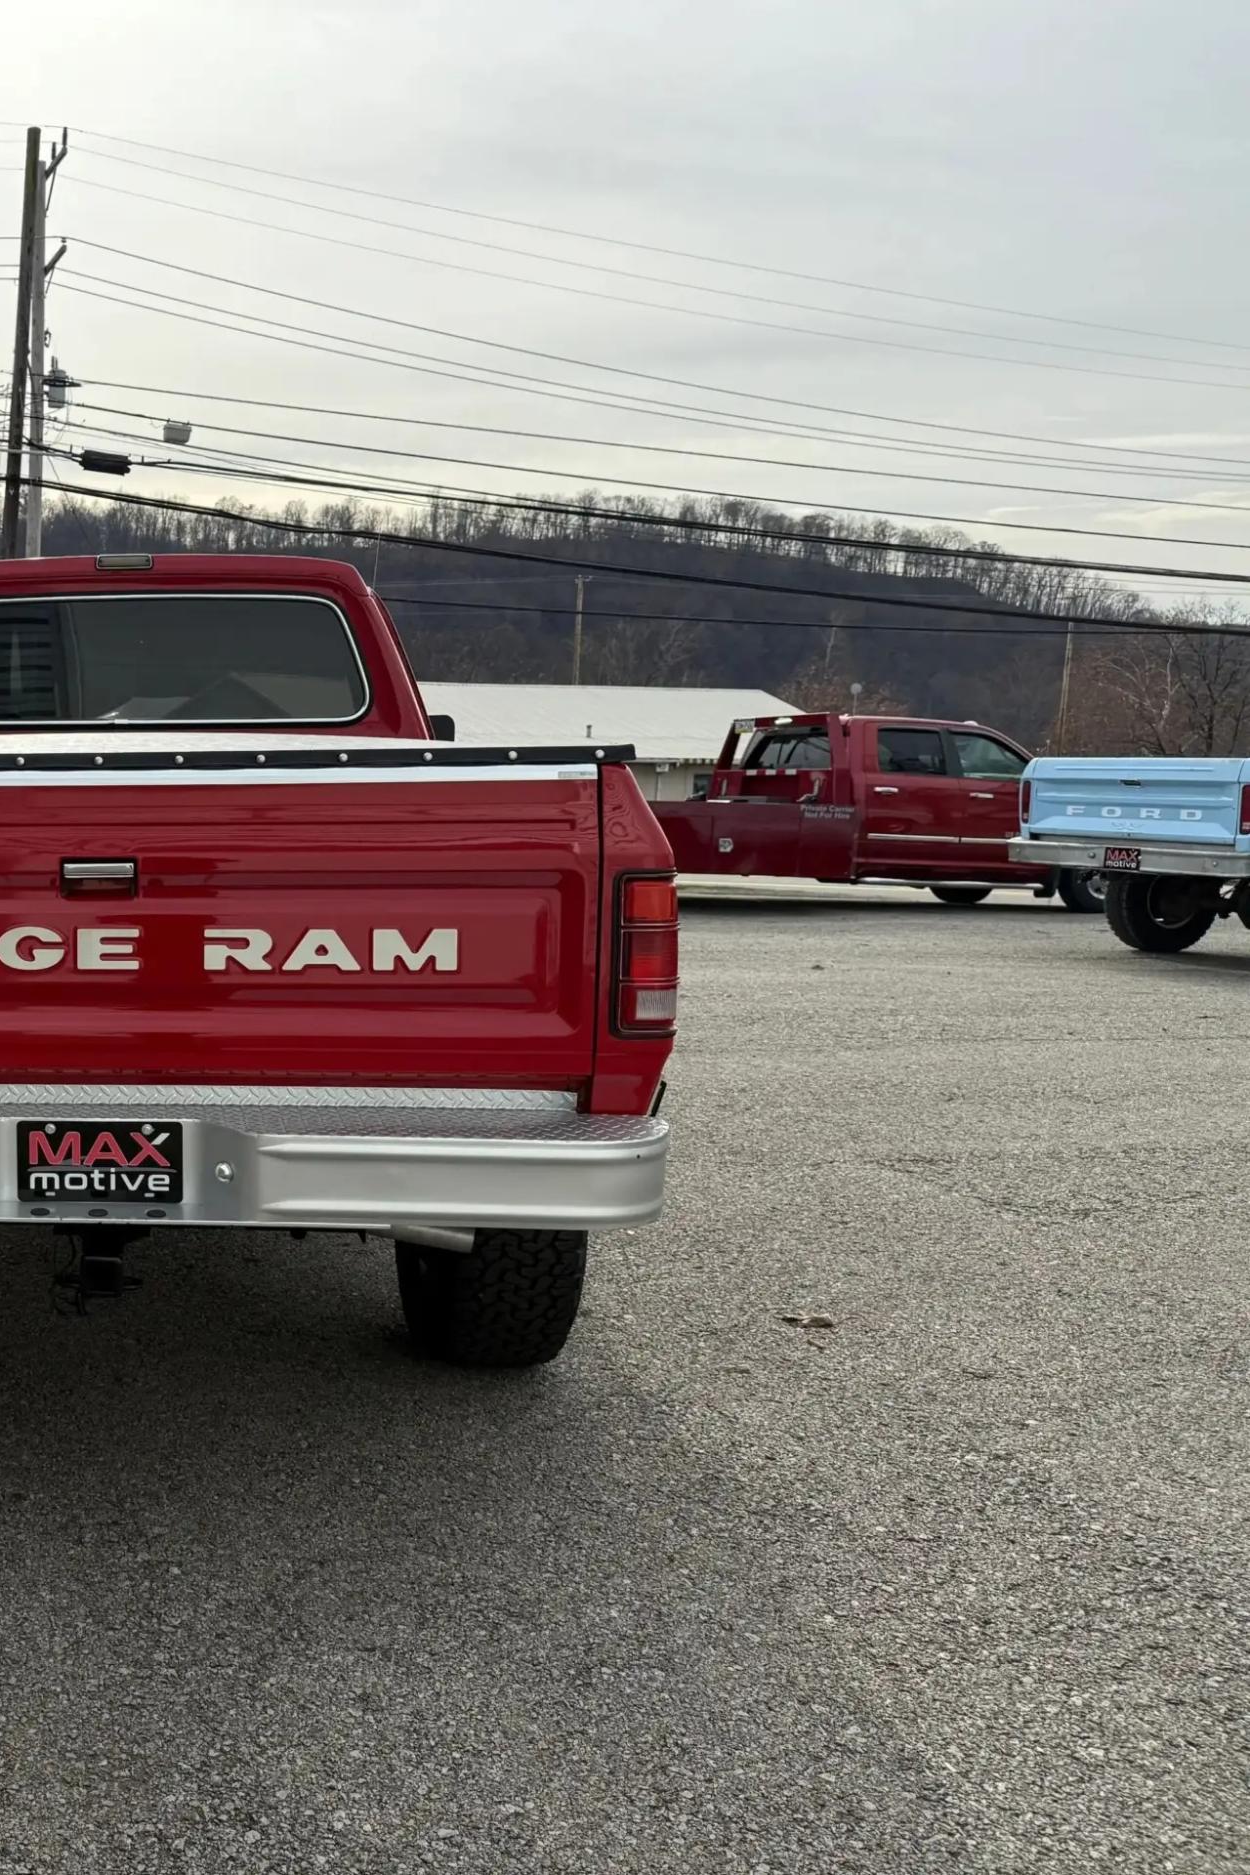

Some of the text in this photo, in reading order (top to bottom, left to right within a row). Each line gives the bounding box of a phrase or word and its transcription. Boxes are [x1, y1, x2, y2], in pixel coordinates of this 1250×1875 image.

[1065, 805, 1203, 821] FORD
[1105, 859, 1138, 869] motive
[1106, 849, 1139, 862] MAX
[203, 927, 459, 972] RAM
[28, 1130, 171, 1167] MAX
[29, 1167, 171, 1192] motive
